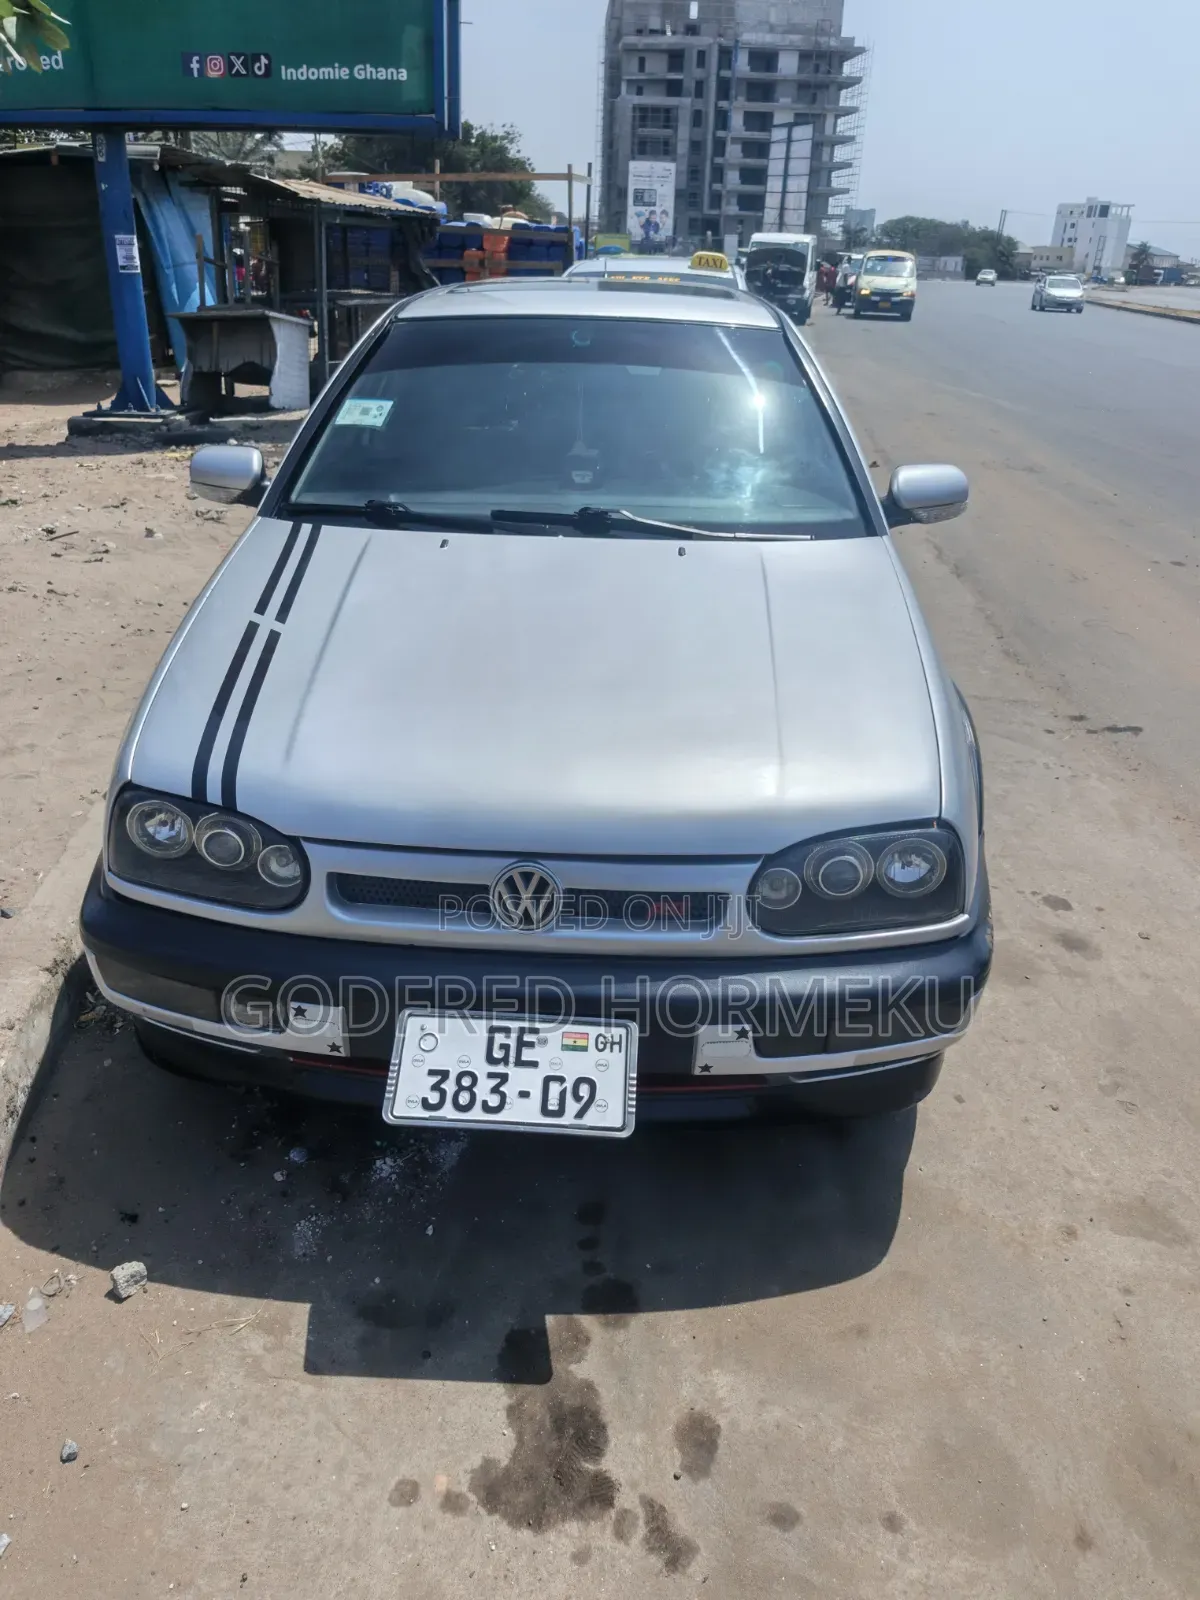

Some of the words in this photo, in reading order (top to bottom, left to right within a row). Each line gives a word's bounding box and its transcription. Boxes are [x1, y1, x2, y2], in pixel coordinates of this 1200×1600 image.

[281, 63, 350, 80] Indomie
[353, 64, 408, 81] Ghana
[696, 255, 725, 269] TAXI
[485, 1024, 541, 1068] GE
[594, 1033, 623, 1054] GH
[421, 1068, 598, 1120] 383-09
